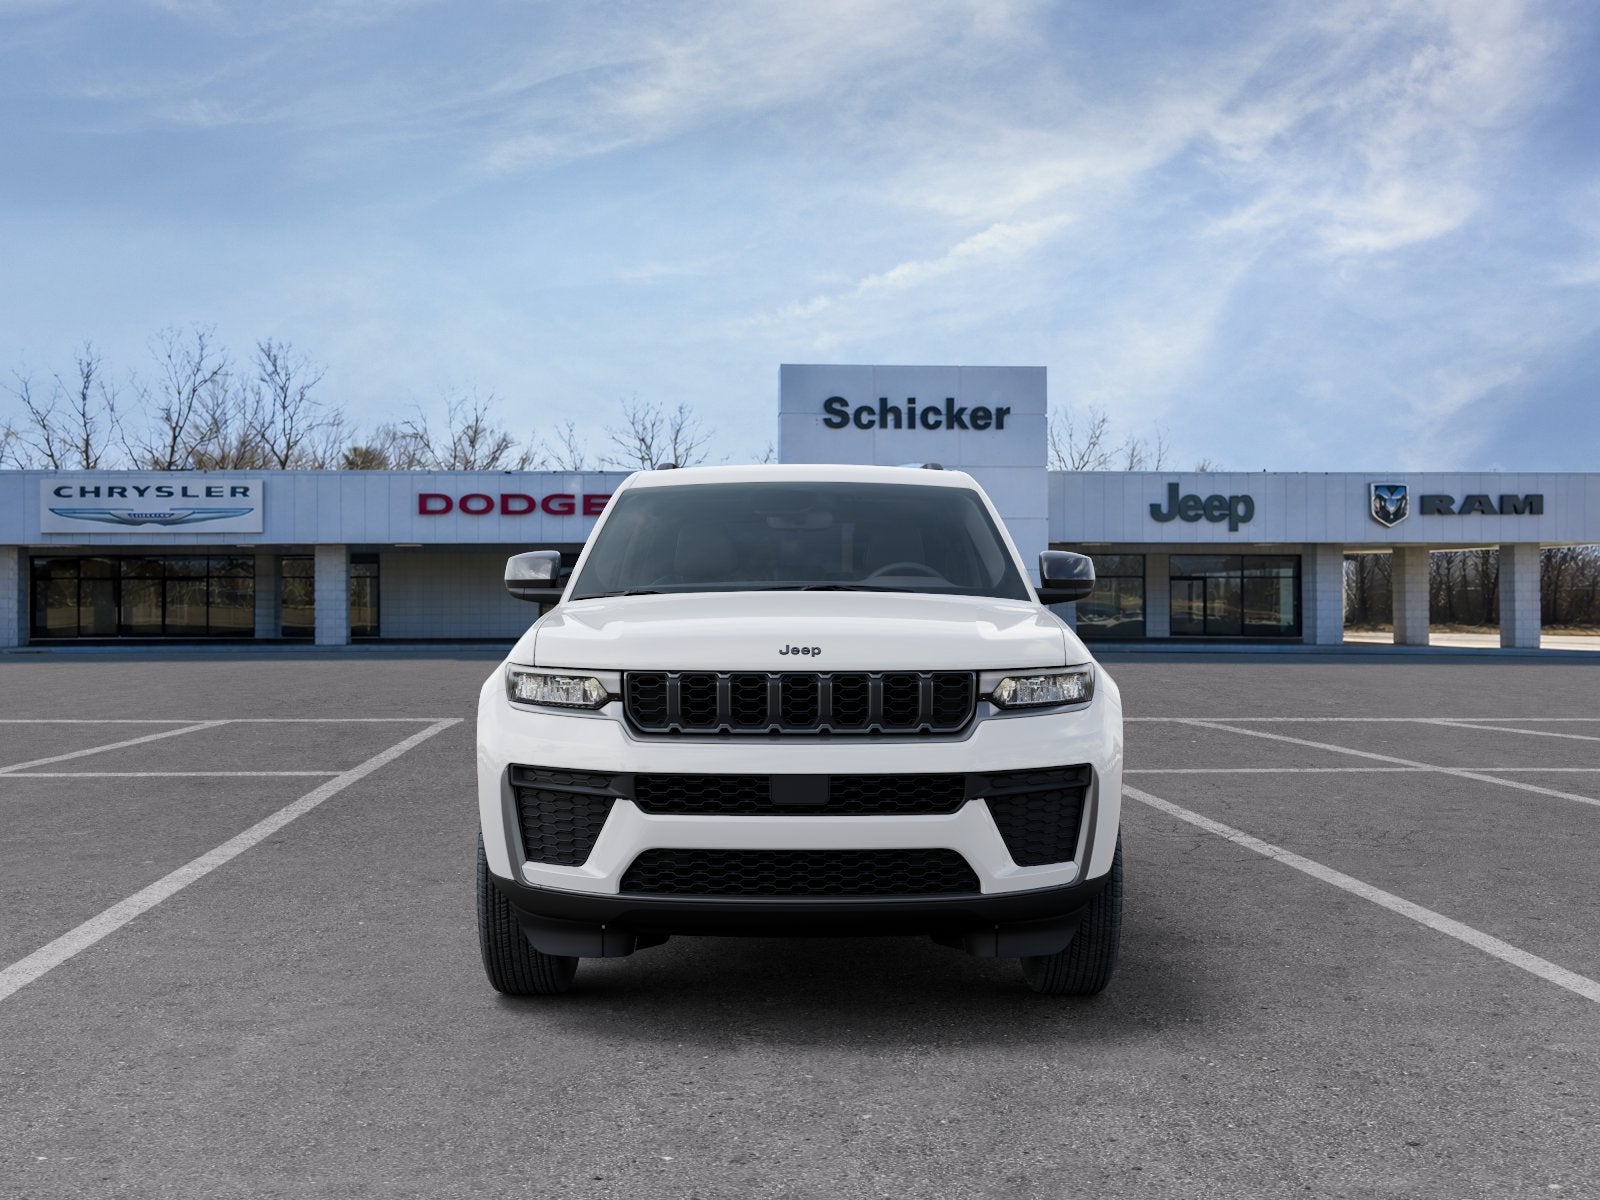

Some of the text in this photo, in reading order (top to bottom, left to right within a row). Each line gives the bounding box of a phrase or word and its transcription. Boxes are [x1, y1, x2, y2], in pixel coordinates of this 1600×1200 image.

[822, 396, 1011, 430] Schicker
[53, 485, 251, 499] CHRYSLER
[1149, 482, 1255, 532] Jeep
[1420, 494, 1544, 516] RAM
[779, 644, 822, 657] Jeep
